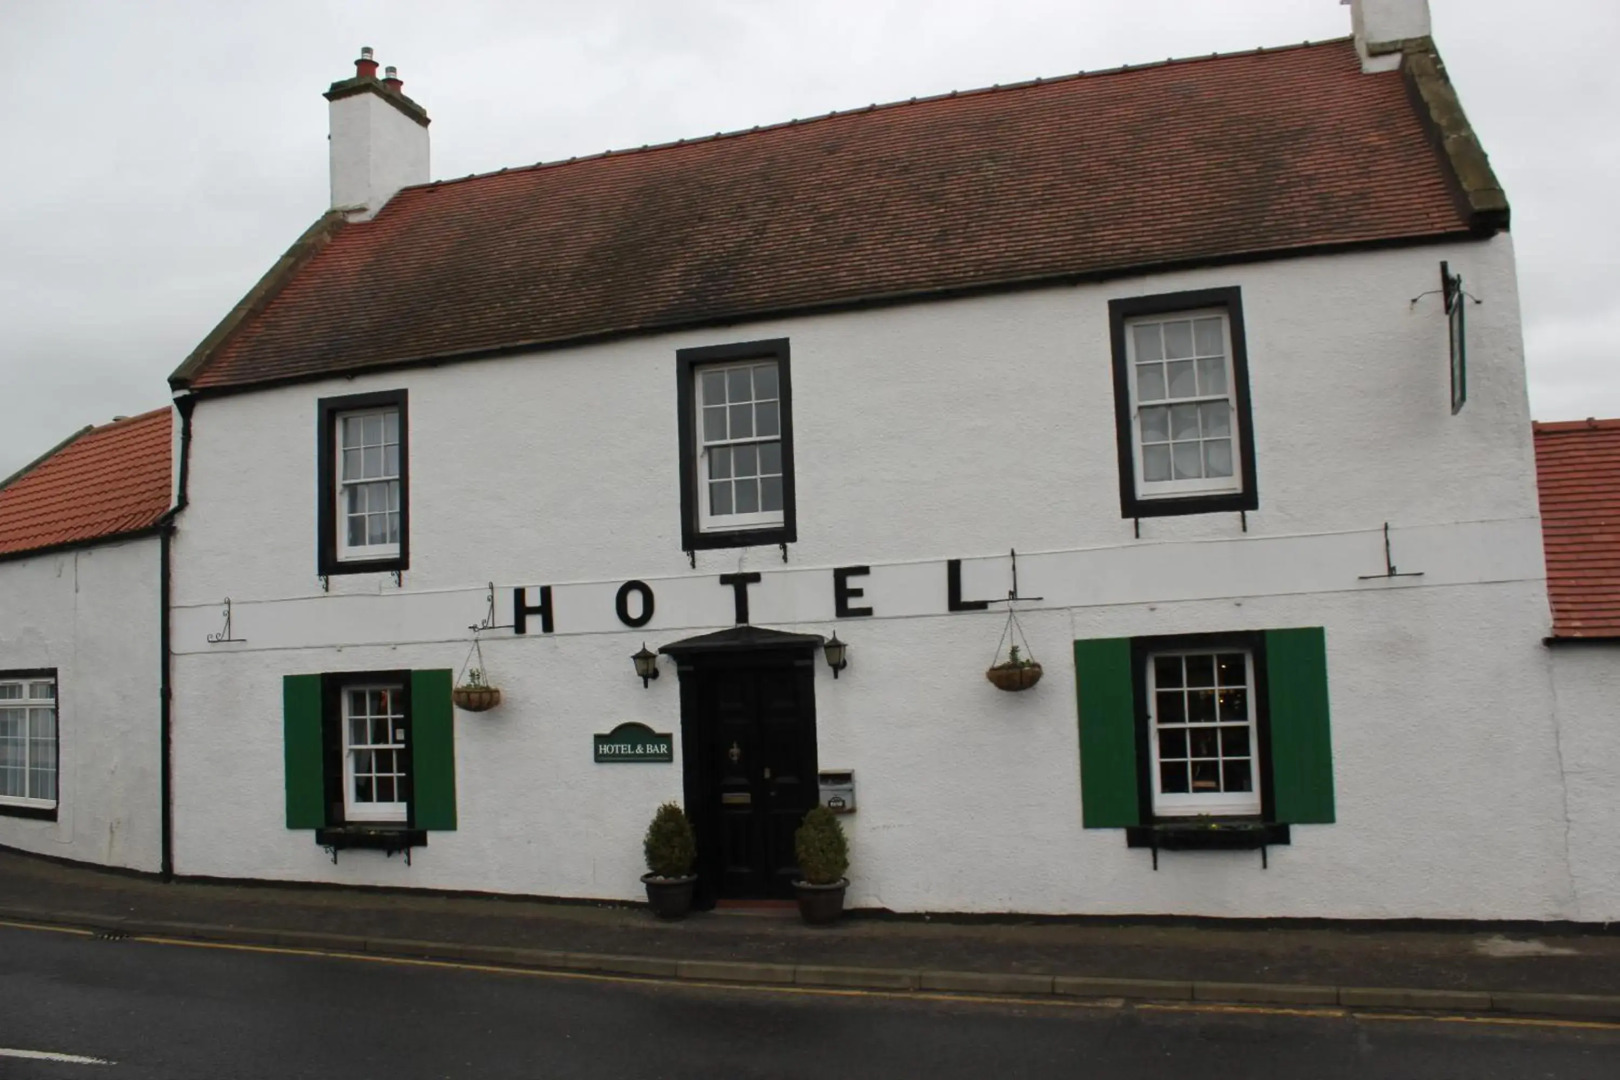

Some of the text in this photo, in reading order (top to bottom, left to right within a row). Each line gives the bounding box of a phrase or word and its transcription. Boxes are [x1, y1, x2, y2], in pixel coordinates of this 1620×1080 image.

[514, 559, 988, 634] HOTEL
[599, 744, 668, 754] HOTEL & BAR
